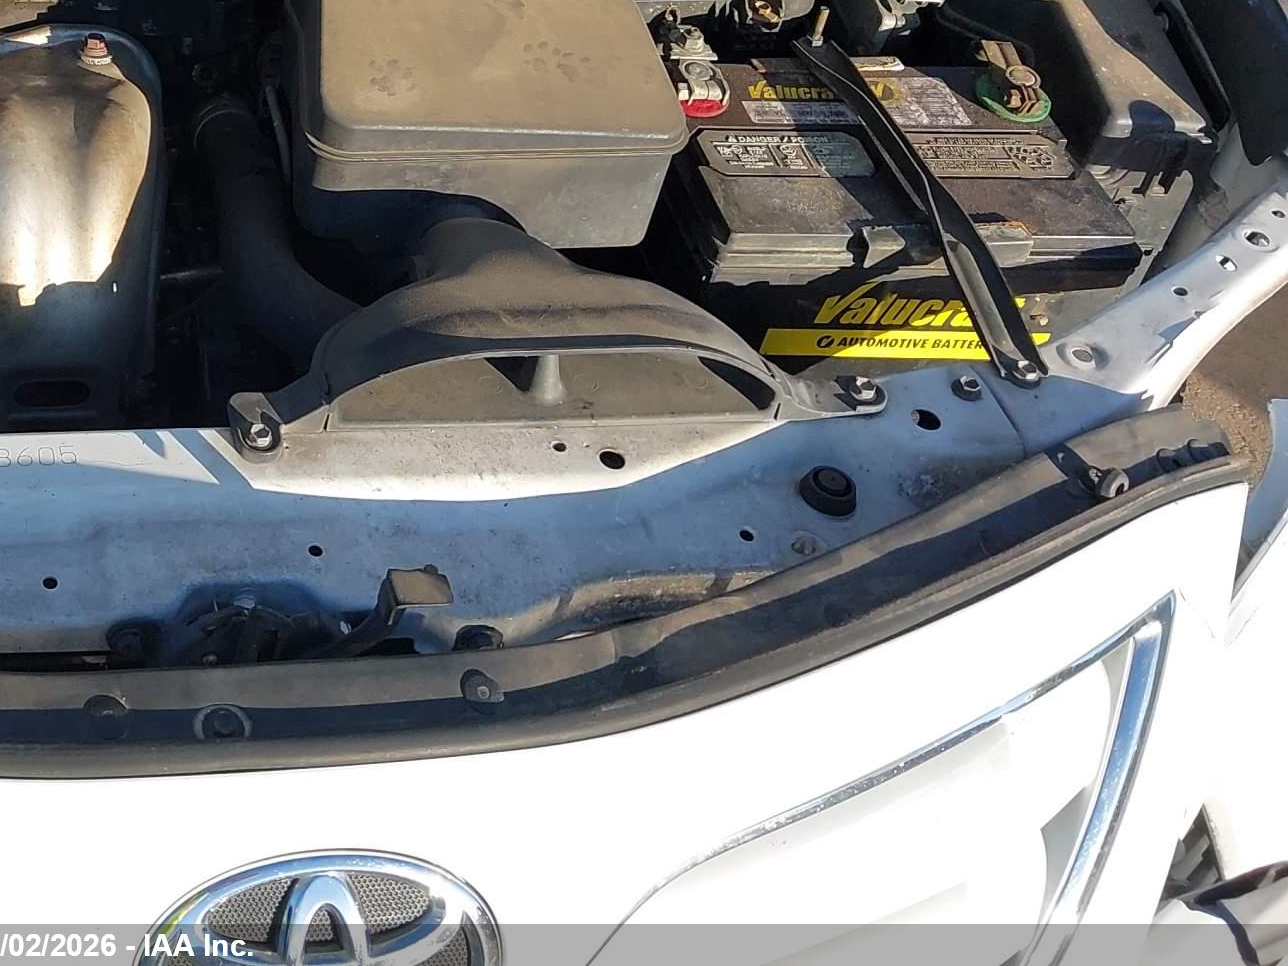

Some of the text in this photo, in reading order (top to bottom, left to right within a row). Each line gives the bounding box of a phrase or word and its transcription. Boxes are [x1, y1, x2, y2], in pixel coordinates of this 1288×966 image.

[748, 79, 834, 101] Valucra
[813, 281, 975, 328] Valucra
[837, 336, 984, 350] AUTOMOTIVE BATTER
